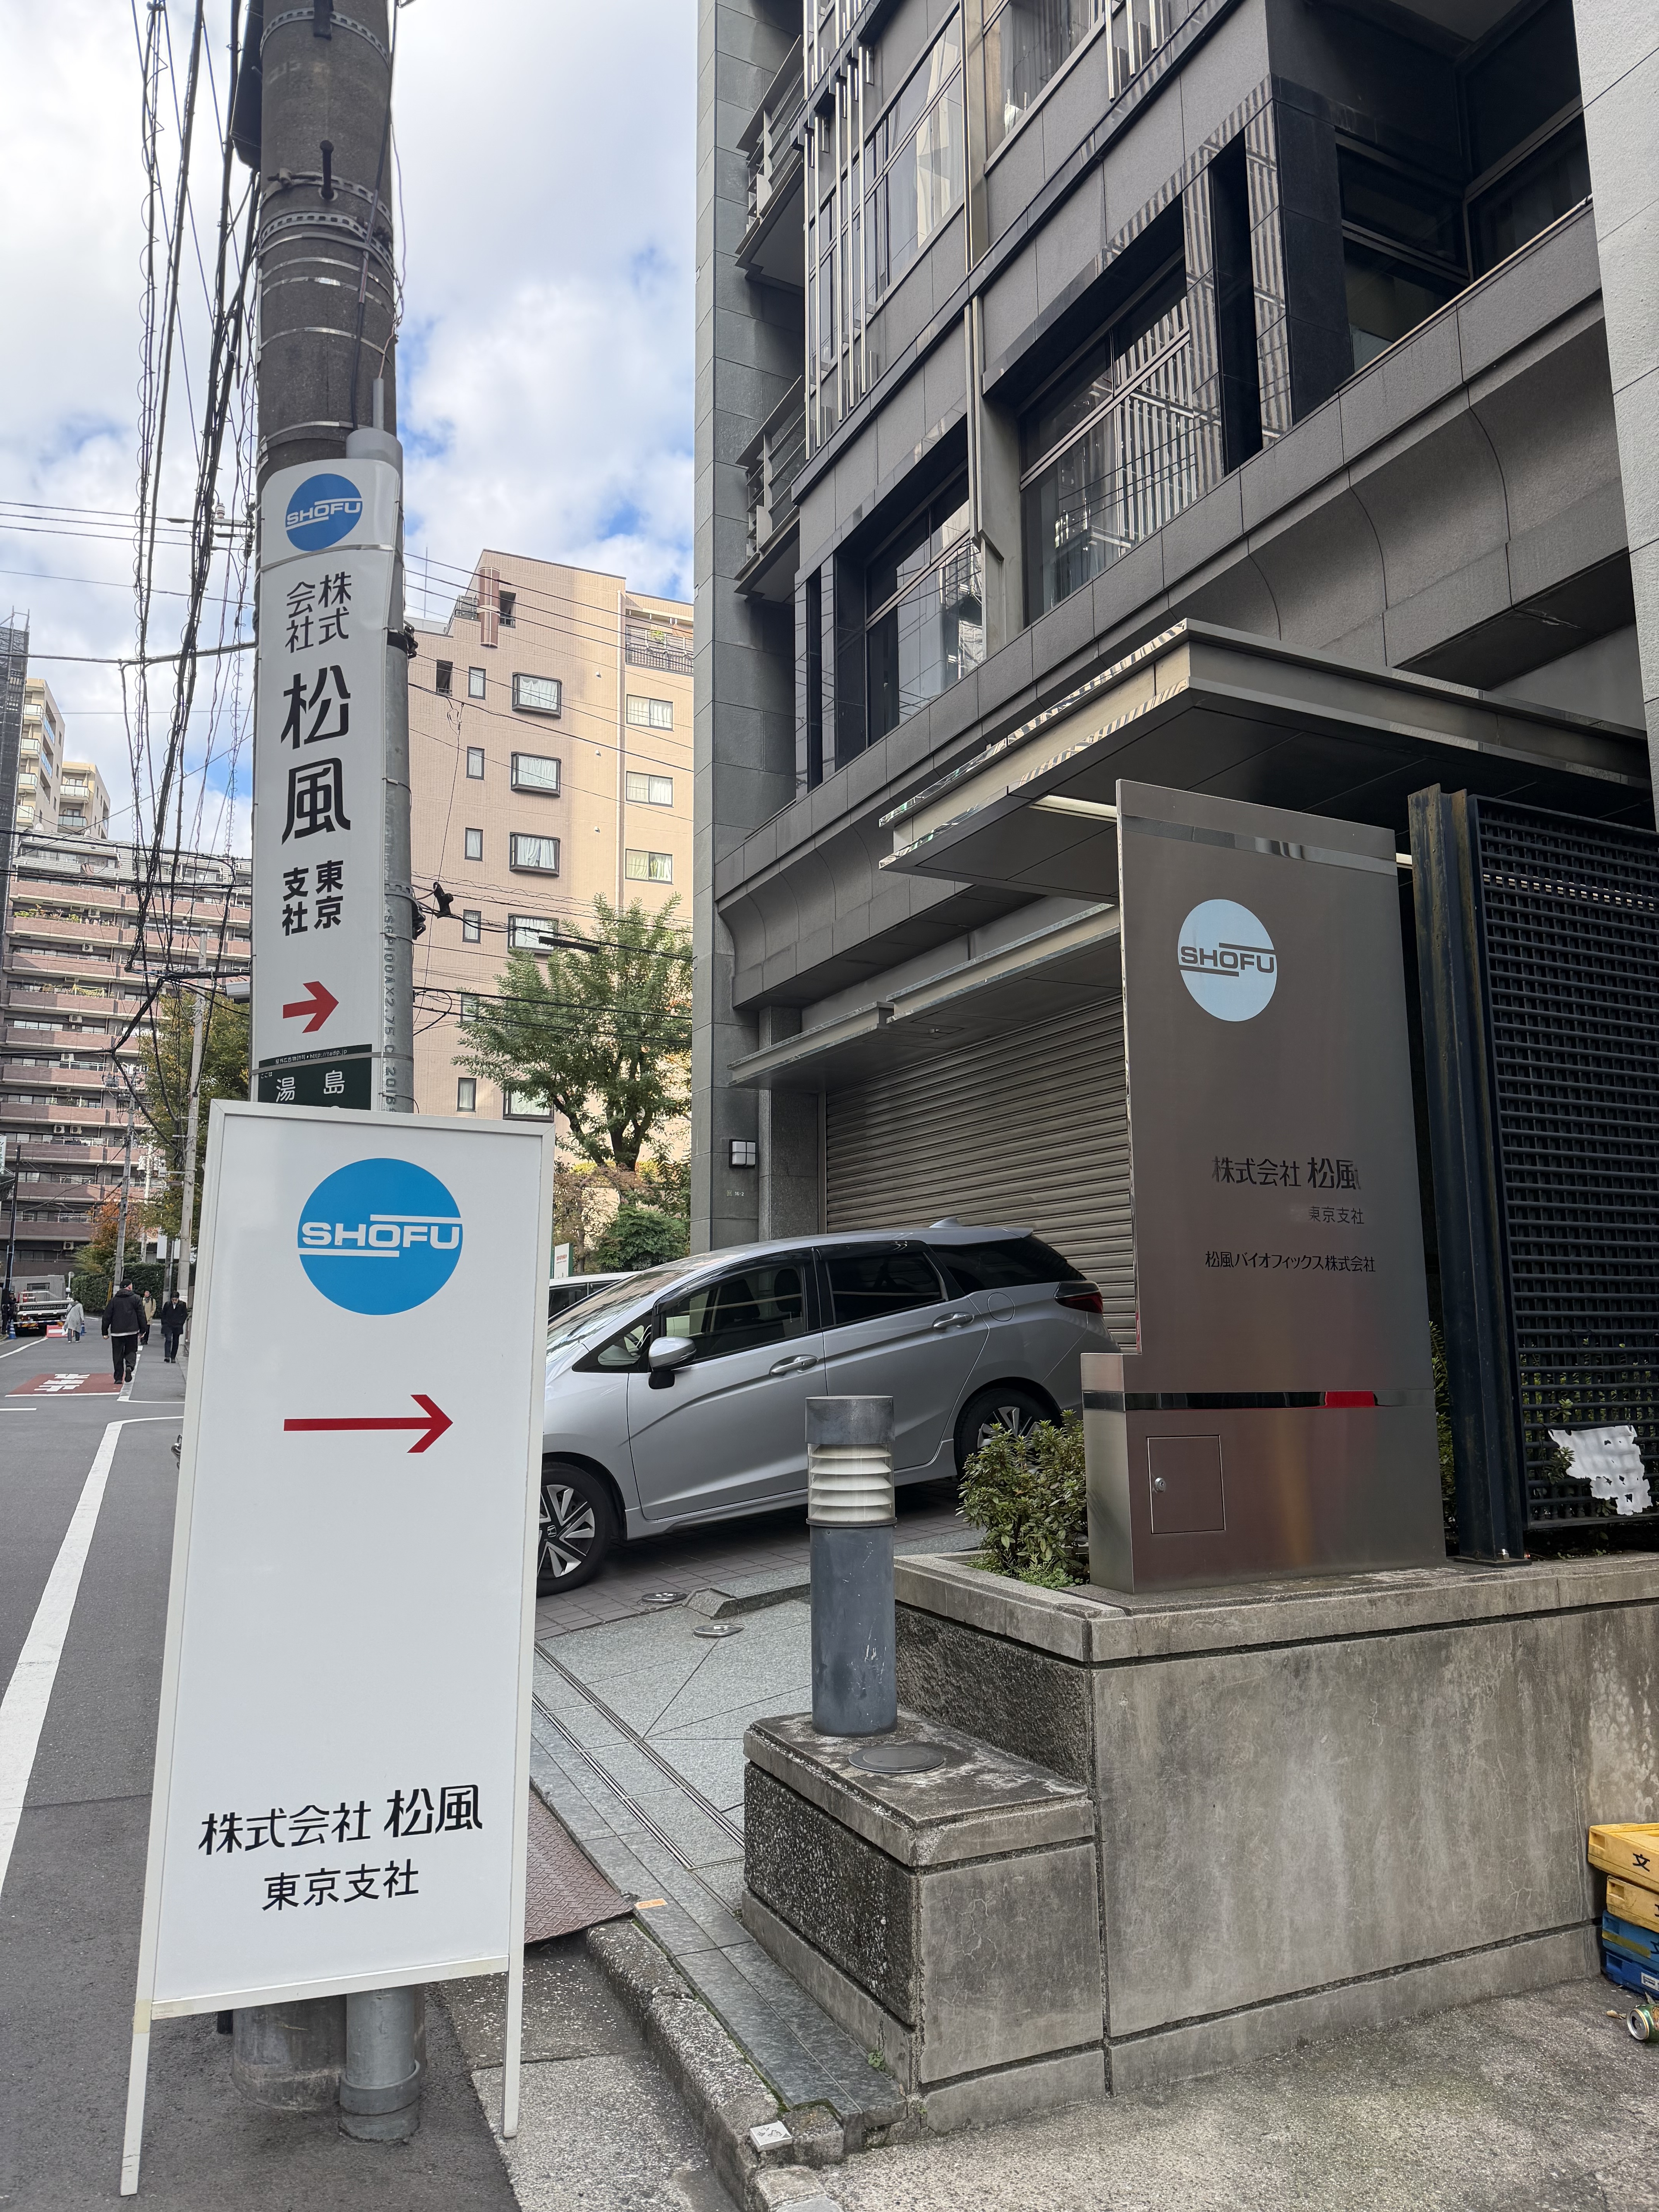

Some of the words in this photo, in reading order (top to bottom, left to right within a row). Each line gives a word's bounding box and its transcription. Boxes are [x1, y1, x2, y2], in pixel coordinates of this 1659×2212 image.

[287, 502, 361, 525] SHOFU
[285, 581, 316, 653] 会社
[318, 571, 352, 646] 株式
[281, 665, 351, 845] 松風
[282, 867, 309, 936] 支社
[314, 860, 344, 929] 東京
[1180, 946, 1274, 974] SHOFU
[276, 1070, 345, 1103] 湯島
[1212, 1156, 1302, 1187] 株式会社
[1307, 1157, 1362, 1190] 松風
[302, 1221, 460, 1249] SHOFU
[1308, 1205, 1365, 1225] 東京支社
[1205, 1250, 1376, 1273] 松風バイオフィックス株式会社
[198, 1800, 372, 1855] 株式会社
[383, 1784, 483, 1838] 松風
[261, 1858, 419, 1911] 東京支社
